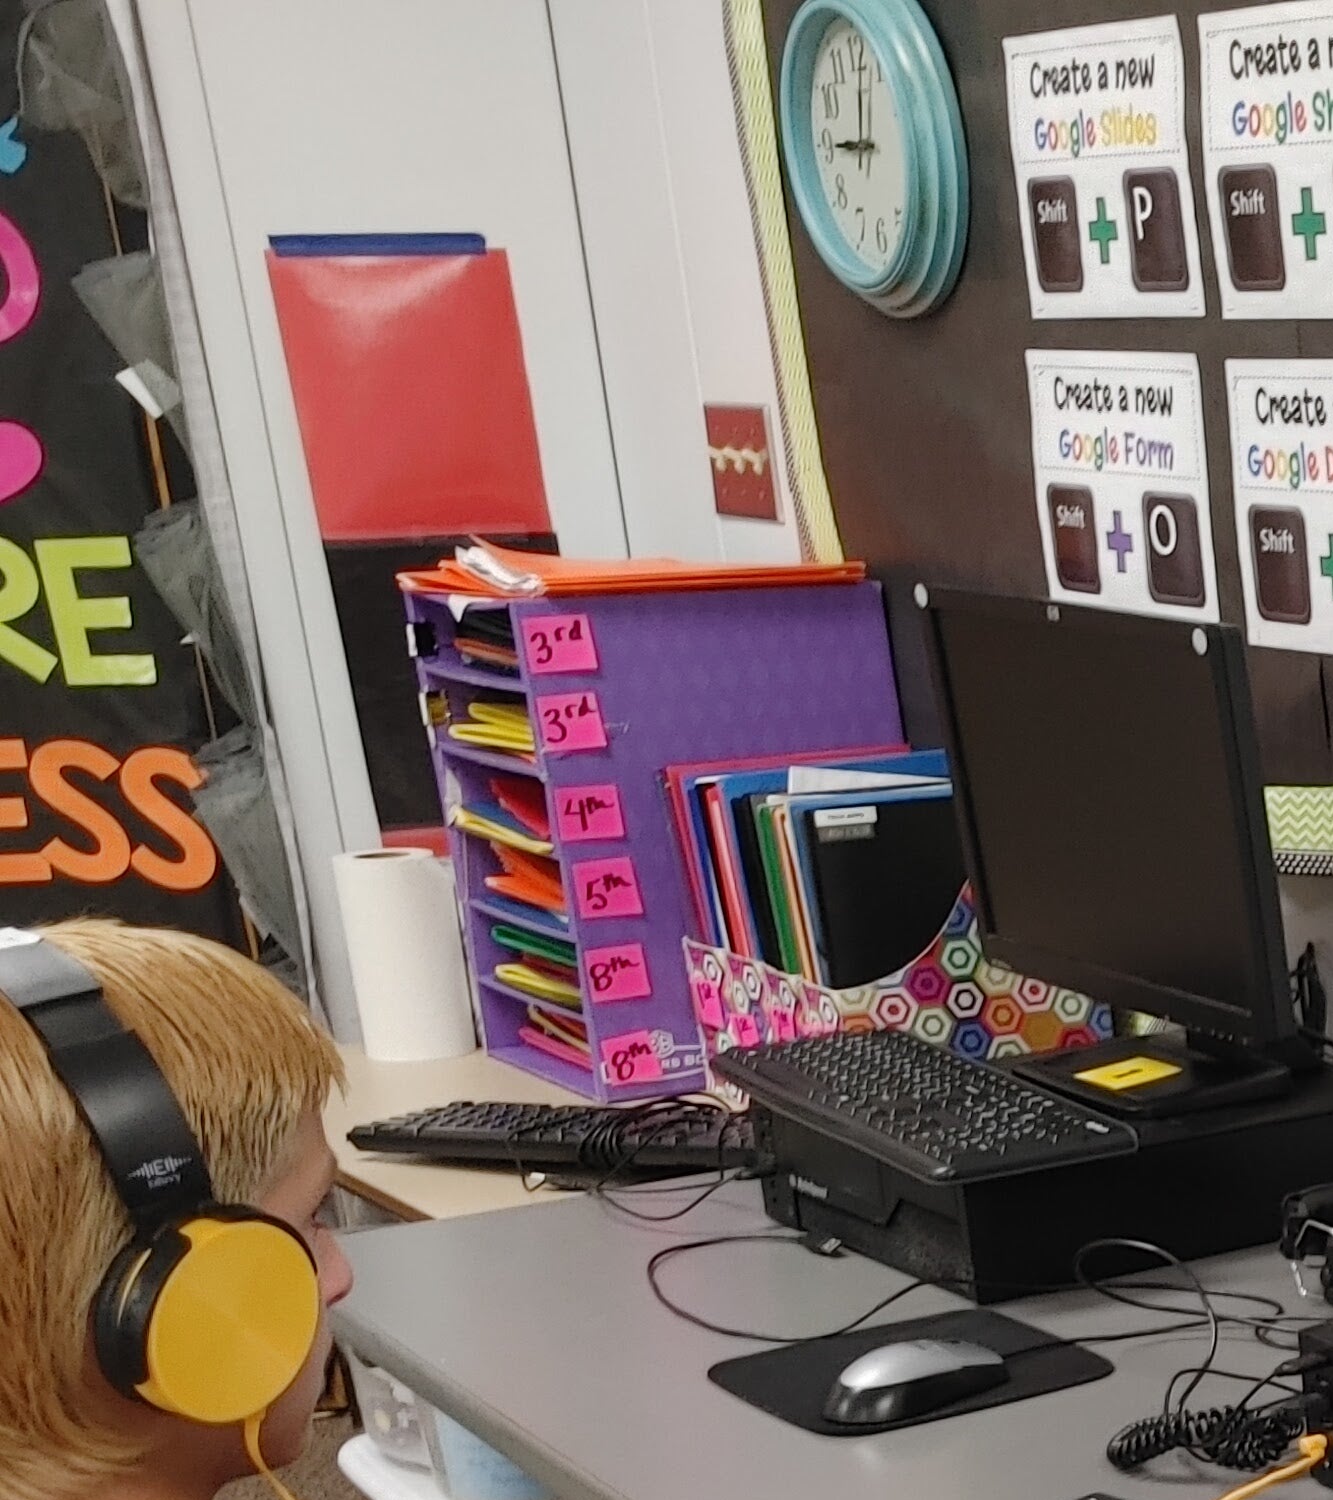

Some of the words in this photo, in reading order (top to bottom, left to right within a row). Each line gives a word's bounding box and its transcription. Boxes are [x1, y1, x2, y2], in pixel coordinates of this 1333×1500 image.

[848, 35, 866, 71] 12
[1230, 40, 1301, 80] Create
[1308, 37, 1320, 68] a
[1030, 61, 1092, 98] Create
[1098, 64, 1110, 91] a
[1115, 55, 1155, 90] new
[1035, 110, 1096, 157] Google
[1100, 110, 1156, 146] Slides
[1233, 93, 1307, 145] Google
[822, 128, 834, 164] 9
[835, 173, 848, 210] 8
[1231, 187, 1265, 217] Shift
[855, 207, 866, 244] 7
[875, 217, 888, 253] 6
[1038, 200, 1067, 224] Shift
[1132, 187, 1153, 241] P
[1054, 376, 1113, 413] Create
[1119, 384, 1129, 411] a
[1135, 383, 1173, 417] new
[1255, 388, 1327, 425] Create
[1058, 428, 1119, 471] Google
[1124, 431, 1174, 471] Form
[1248, 443, 1319, 488] Google
[1056, 505, 1087, 530] Shift
[1149, 504, 1178, 556] O
[1259, 528, 1295, 555] Shift
[529, 620, 584, 665] 3rd
[543, 695, 596, 744] 3rd
